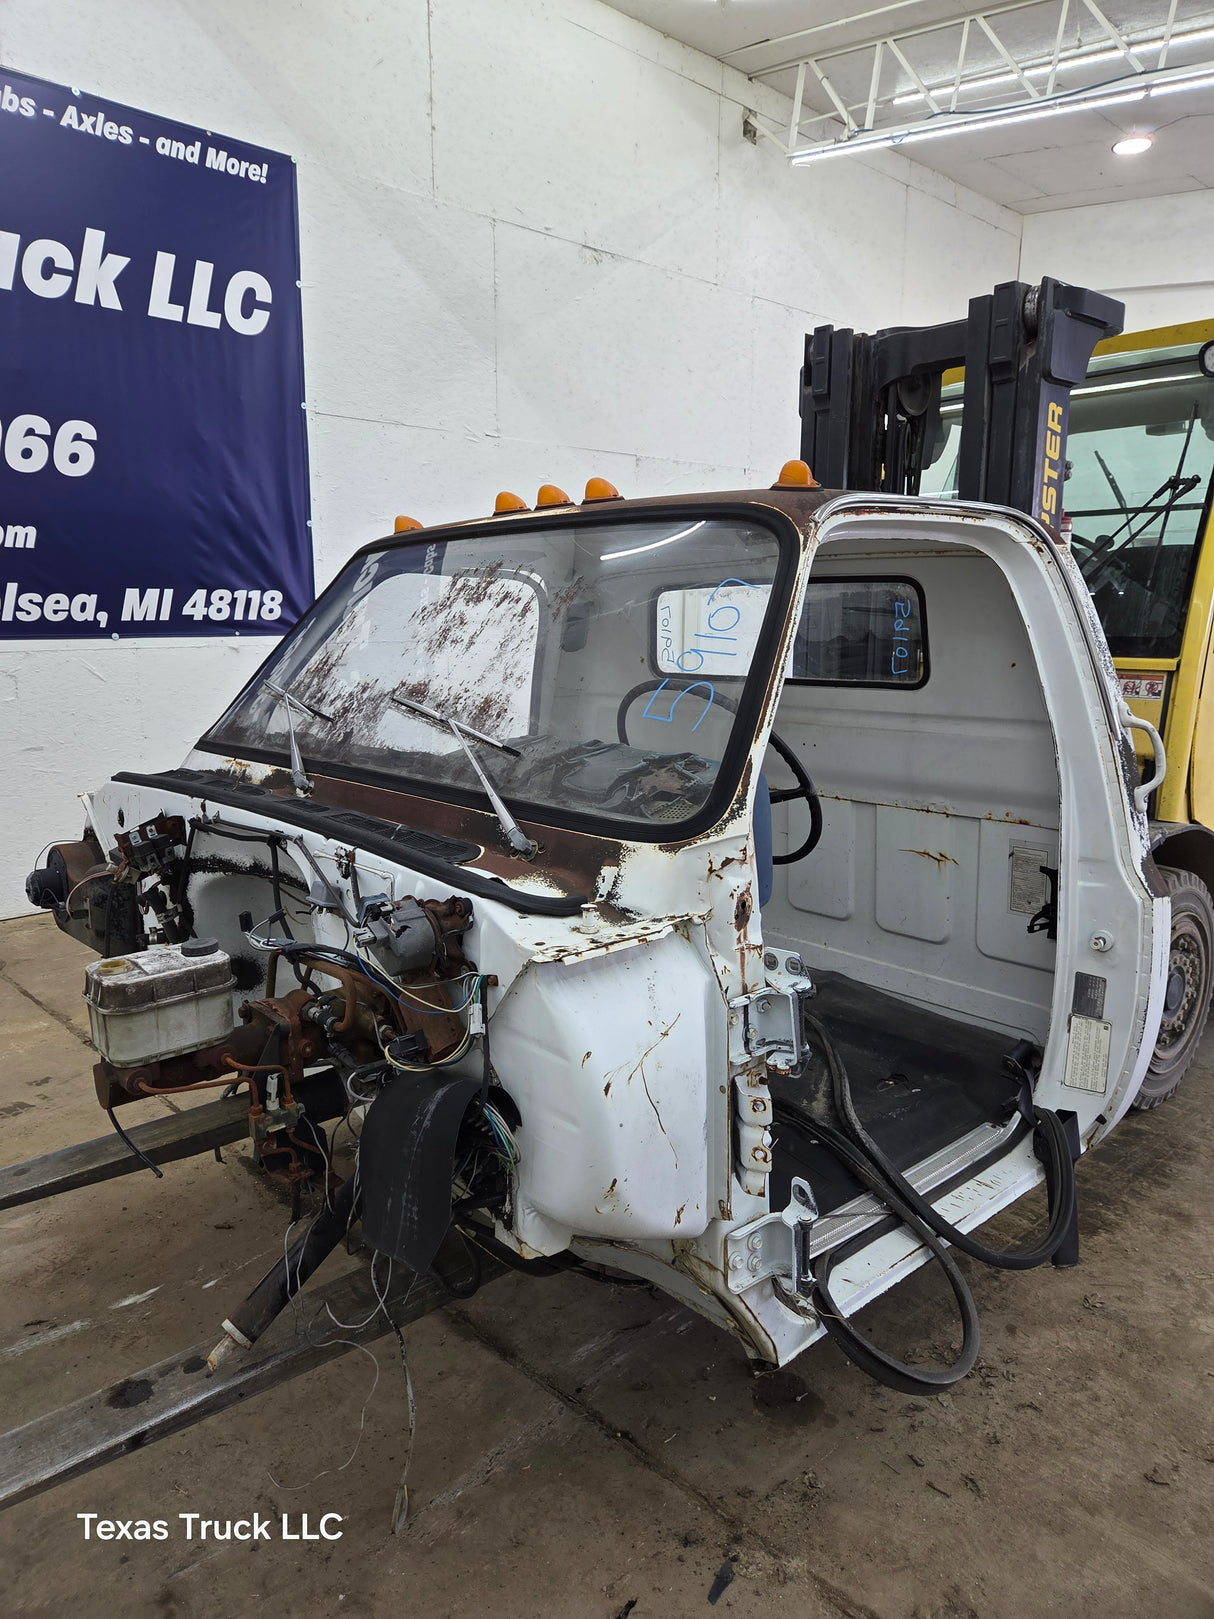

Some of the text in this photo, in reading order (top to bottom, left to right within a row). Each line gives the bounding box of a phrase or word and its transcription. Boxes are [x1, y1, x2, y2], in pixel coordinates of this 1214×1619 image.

[0, 84, 36, 117] bs
[60, 105, 133, 145] Axles
[155, 136, 201, 165] and
[205, 146, 269, 184] More!
[147, 250, 273, 336] LLC
[0, 413, 98, 477] 66
[0, 524, 37, 549] m
[0, 582, 283, 628] lsea, MI 48118
